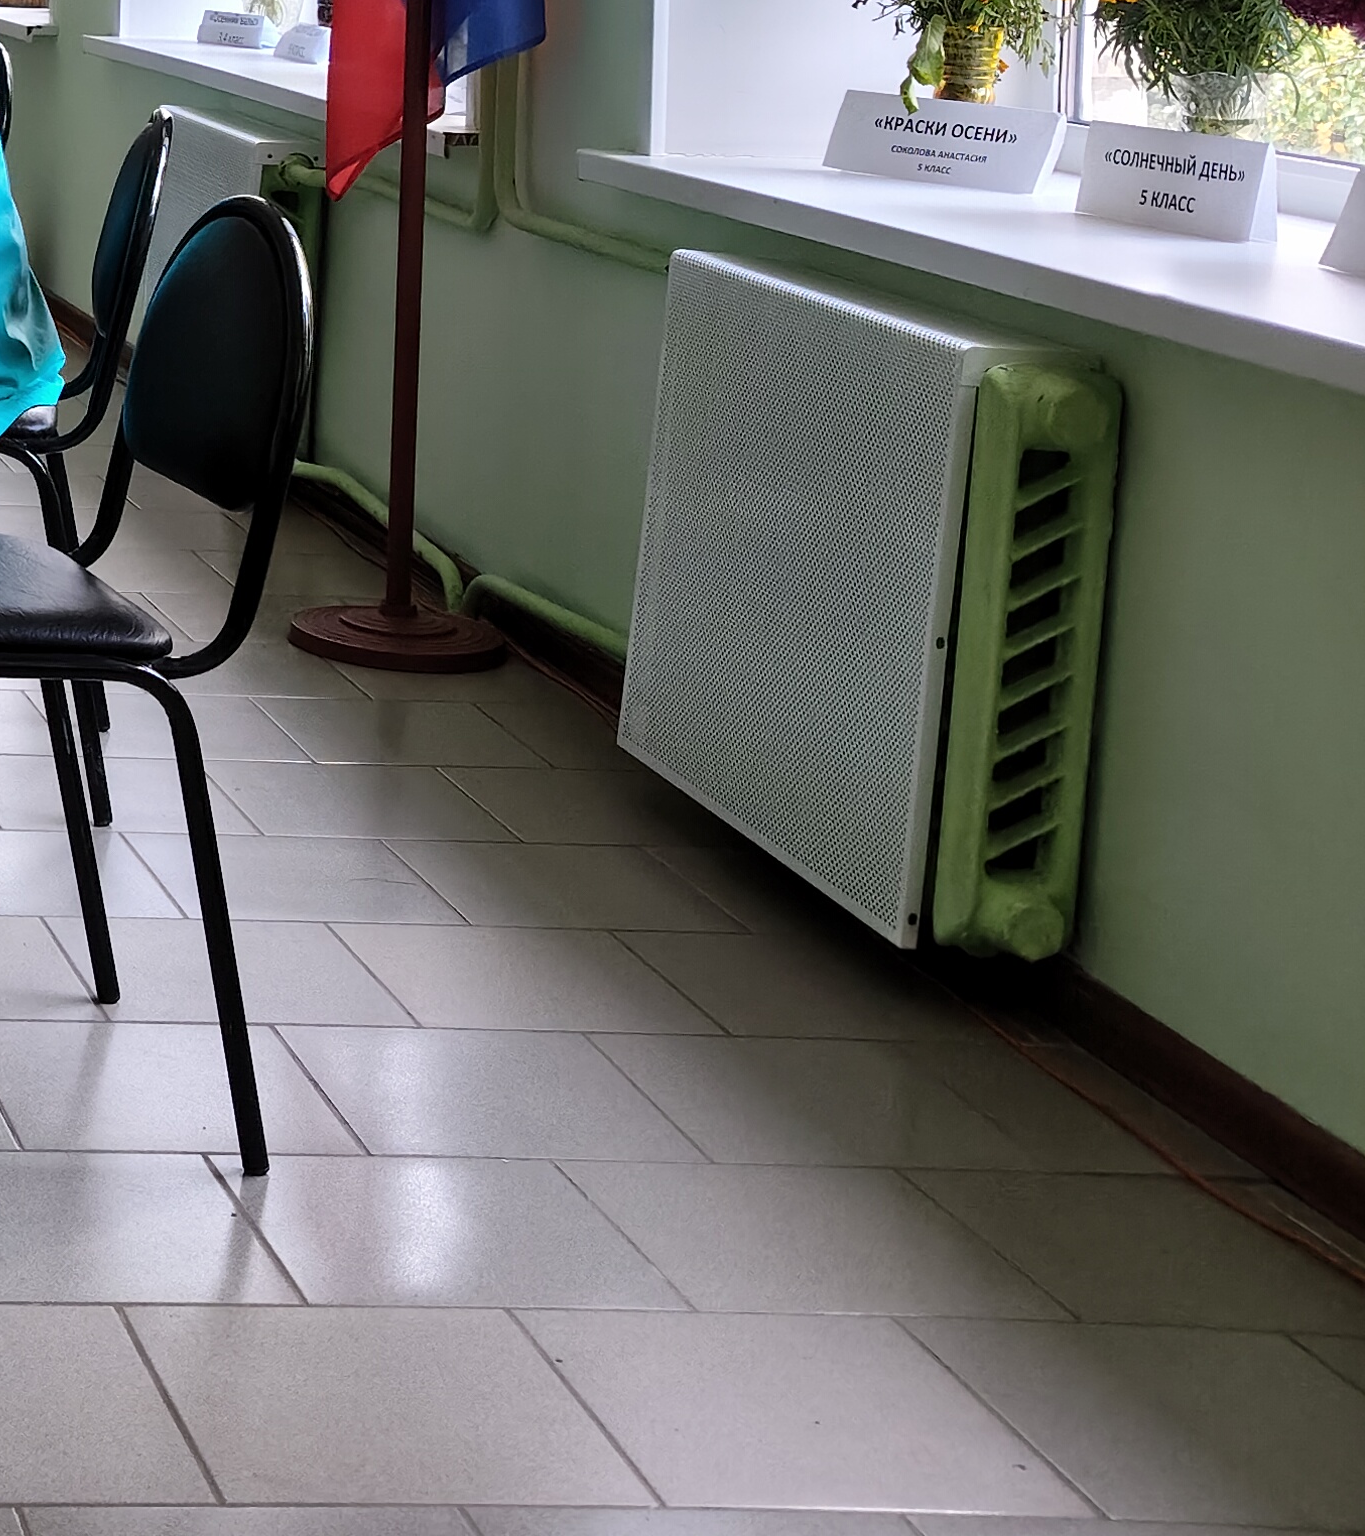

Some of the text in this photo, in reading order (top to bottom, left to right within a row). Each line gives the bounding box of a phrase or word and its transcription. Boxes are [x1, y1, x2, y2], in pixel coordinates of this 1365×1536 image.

[874, 115, 1018, 144] «КРАСКИ ОСЕНИ»
[890, 144, 988, 164] СОКОЛОВА АНАСТАСИЯ
[1104, 148, 1245, 183] «СОЛНЕЧНЫЙ ДЕНЬ»
[917, 163, 952, 175] 5 КЛАСС
[1139, 189, 1196, 214] 5 КЛАСС
